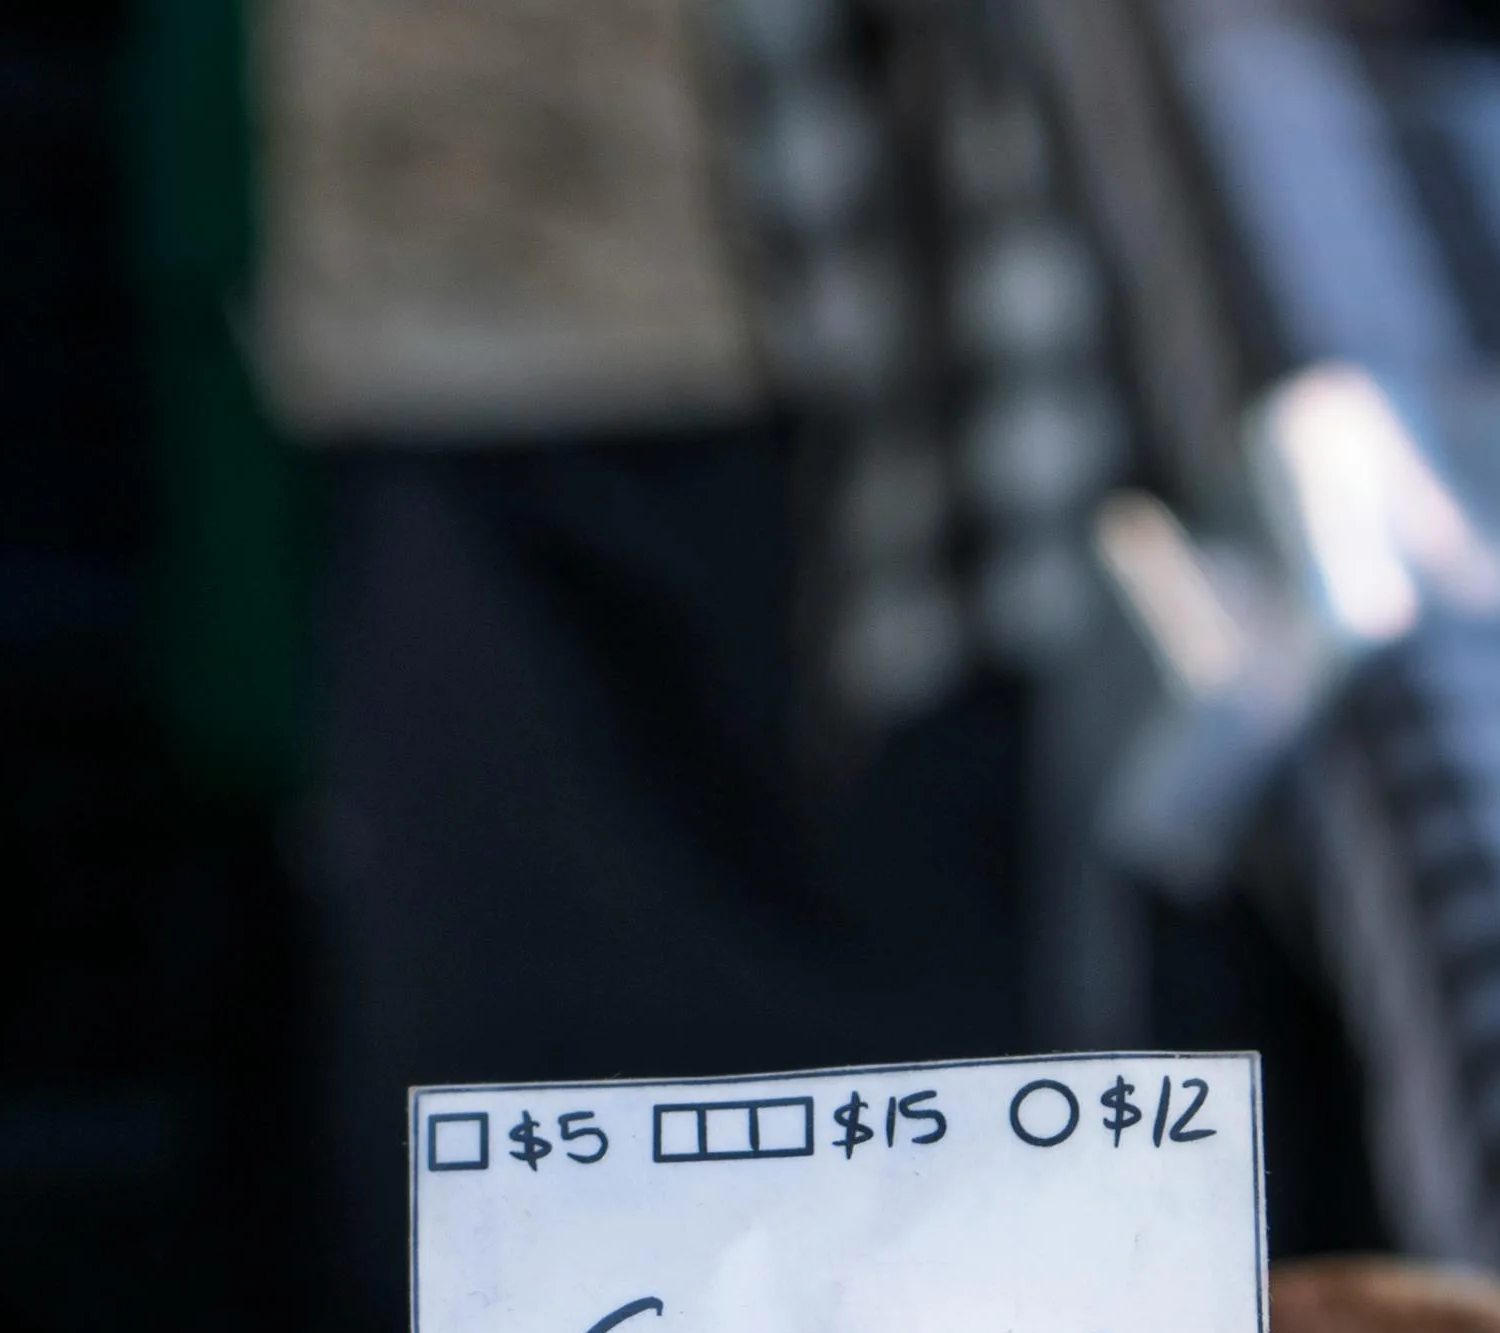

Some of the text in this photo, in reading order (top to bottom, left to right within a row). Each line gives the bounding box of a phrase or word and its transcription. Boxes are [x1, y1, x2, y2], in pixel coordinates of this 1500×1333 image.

[507, 1075, 1219, 1171] $5 $15 $12
